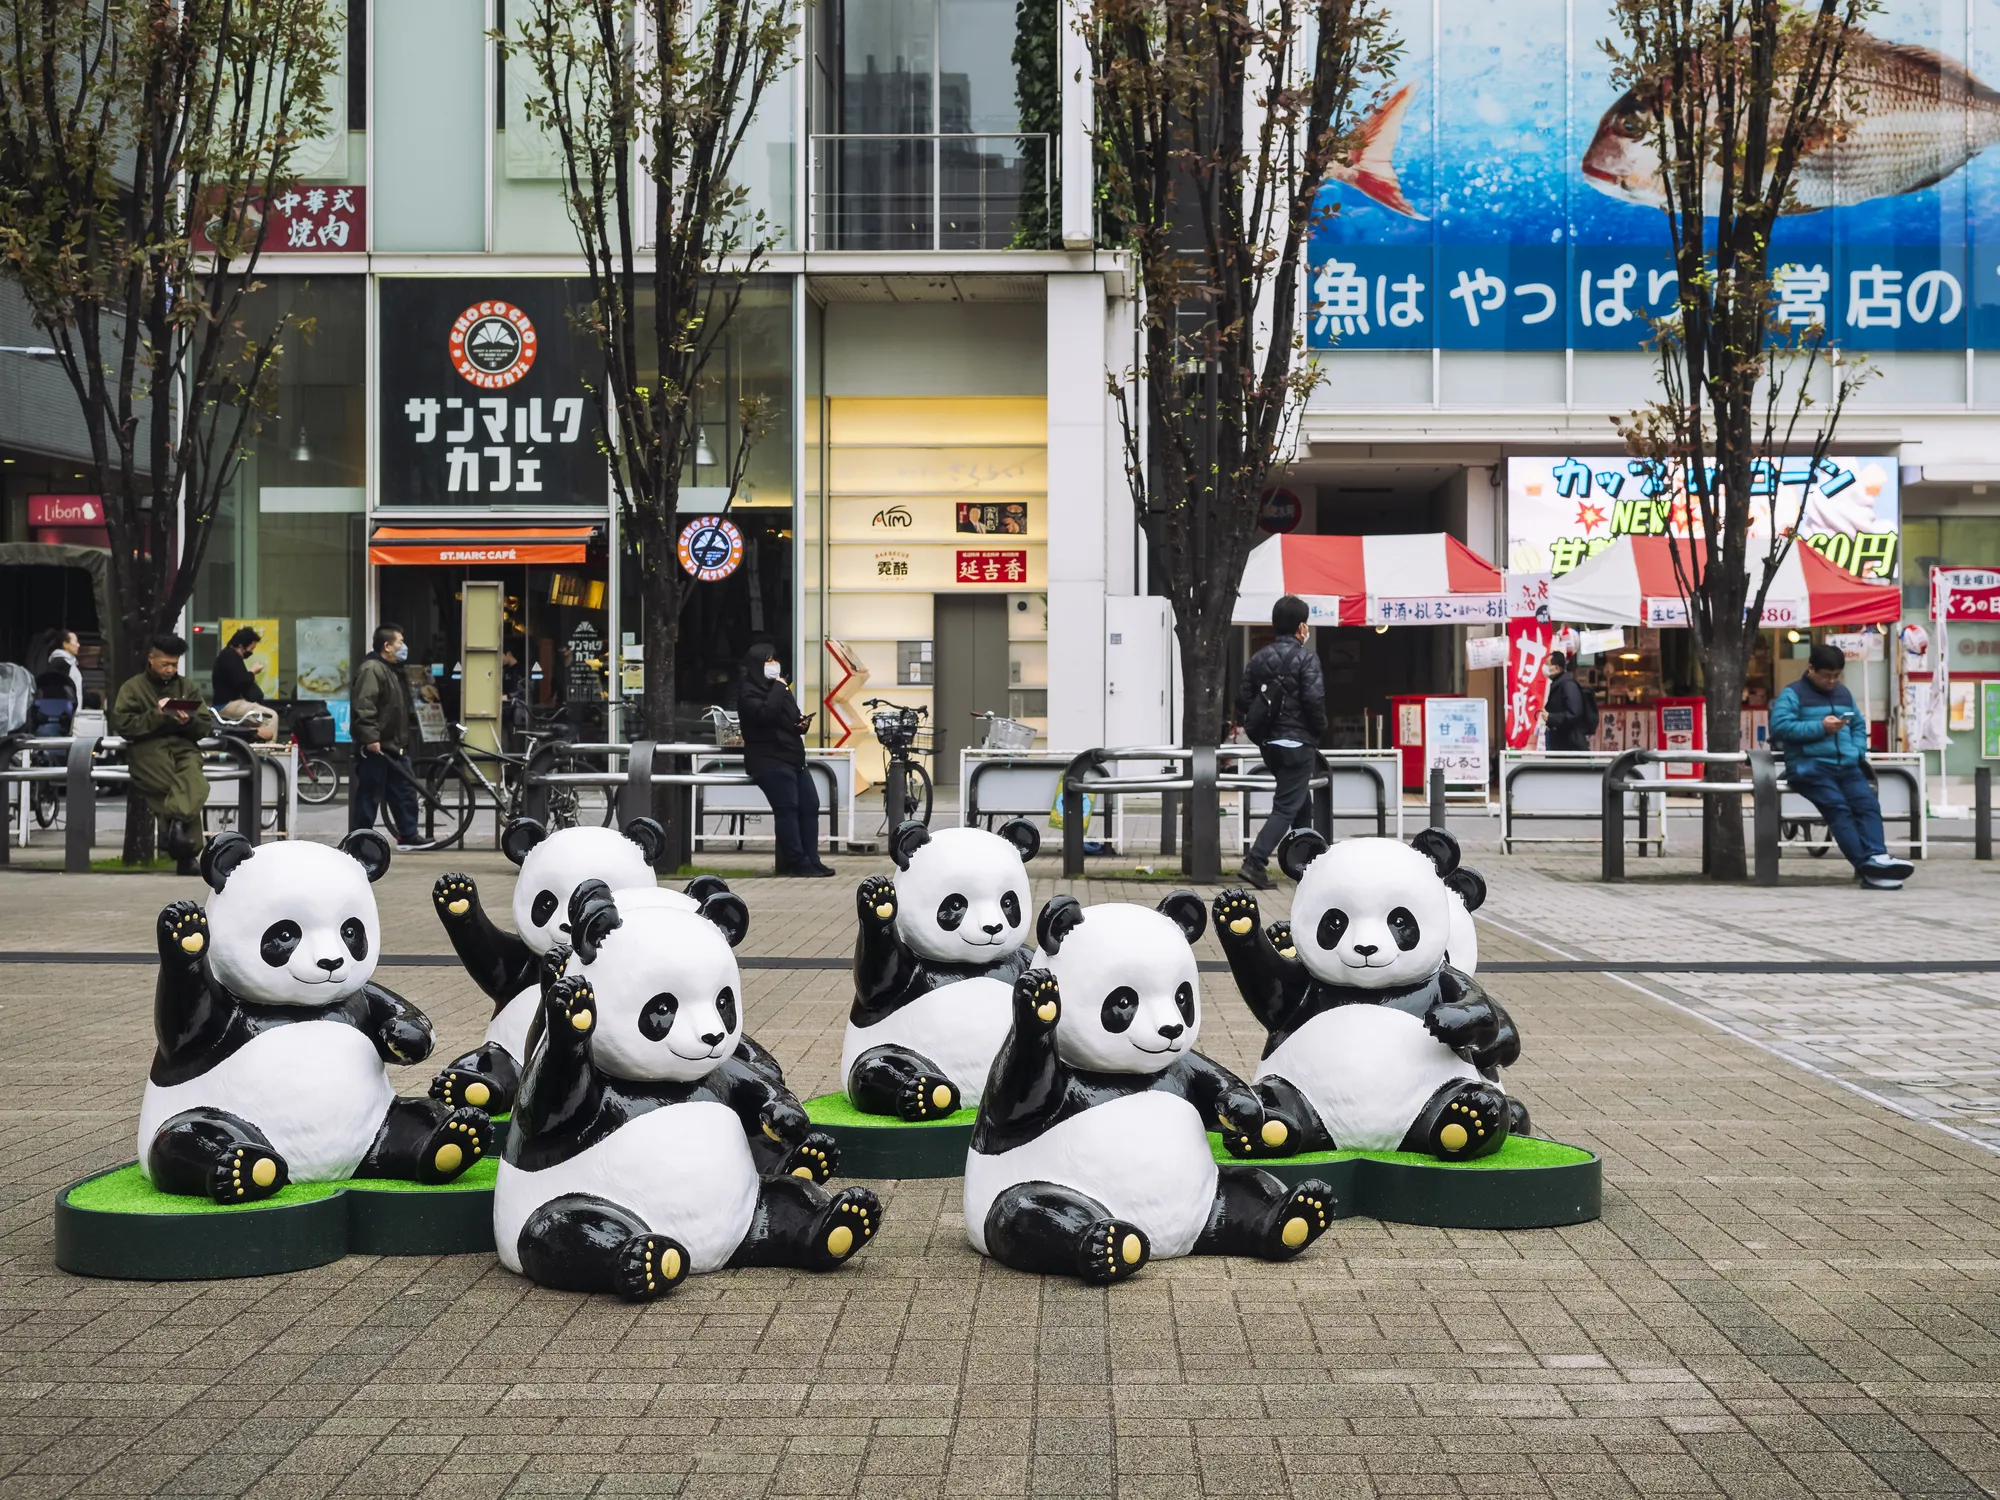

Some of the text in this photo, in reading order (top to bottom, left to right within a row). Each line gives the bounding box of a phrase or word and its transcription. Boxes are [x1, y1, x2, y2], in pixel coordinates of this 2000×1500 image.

[273, 188, 355, 218] 中華式
[287, 214, 350, 248] 焼肉
[404, 397, 584, 443] サンマルク
[446, 446, 543, 492] カフェ
[44, 499, 82, 522] Libon
[1610, 499, 1672, 535] NEW
[439, 548, 517, 561] ST.MARC CAFÉ
[958, 558, 1025, 581] 延吉香
[1433, 756, 1481, 769] おしるこ
